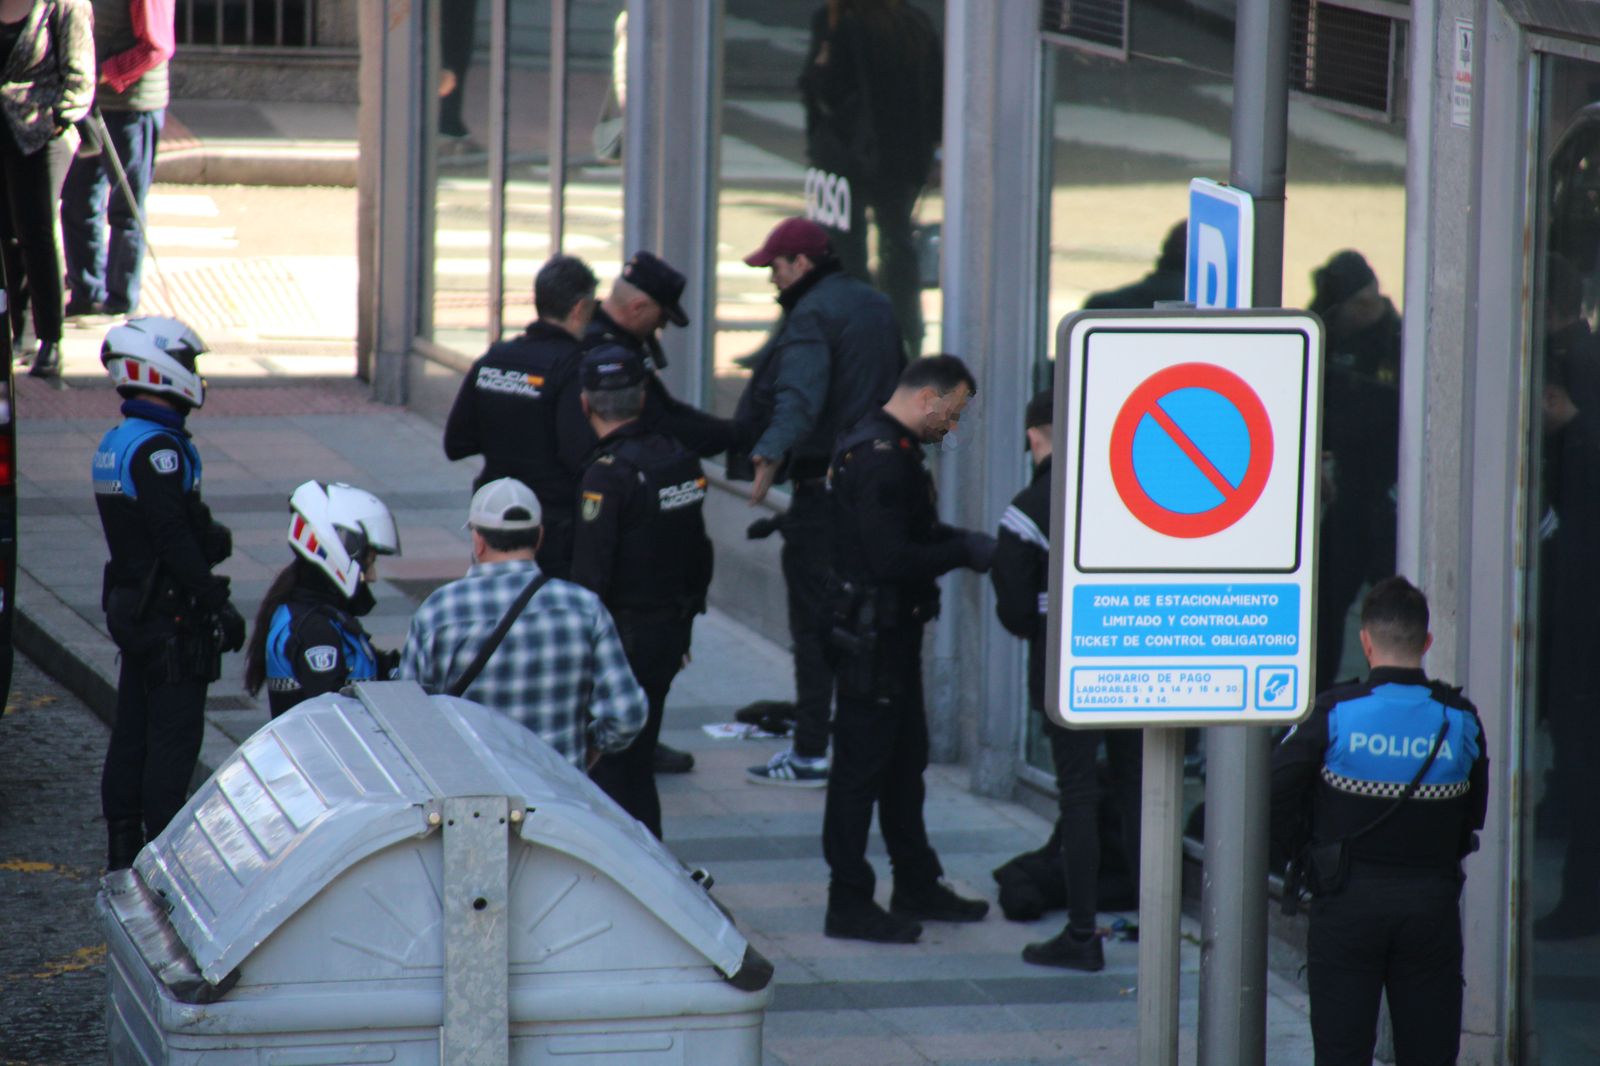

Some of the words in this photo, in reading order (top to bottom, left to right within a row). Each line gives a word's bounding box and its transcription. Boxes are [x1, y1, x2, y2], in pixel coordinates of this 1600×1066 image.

[476, 377, 541, 397] NACIONAL
[1094, 595, 1129, 607] ZONA
[1134, 595, 1151, 606] DE
[1156, 594, 1279, 606] ESTACIONAMIENTO
[1102, 615, 1162, 626] LIMITADO
[1168, 615, 1176, 626] Y
[1180, 614, 1269, 626] CONTROLADO
[1074, 635, 1118, 647] TICKET
[1123, 635, 1140, 646] DE
[1145, 635, 1206, 646] CONTROL
[1211, 634, 1297, 646] OBLIGATORIO
[1098, 673, 1150, 683] HORARIO
[1157, 673, 1172, 683] DE
[1180, 673, 1212, 683] PAGO
[1171, 685, 1181, 693] 14
[1187, 686, 1193, 694] y
[1349, 732, 1453, 760] POLICÍA
